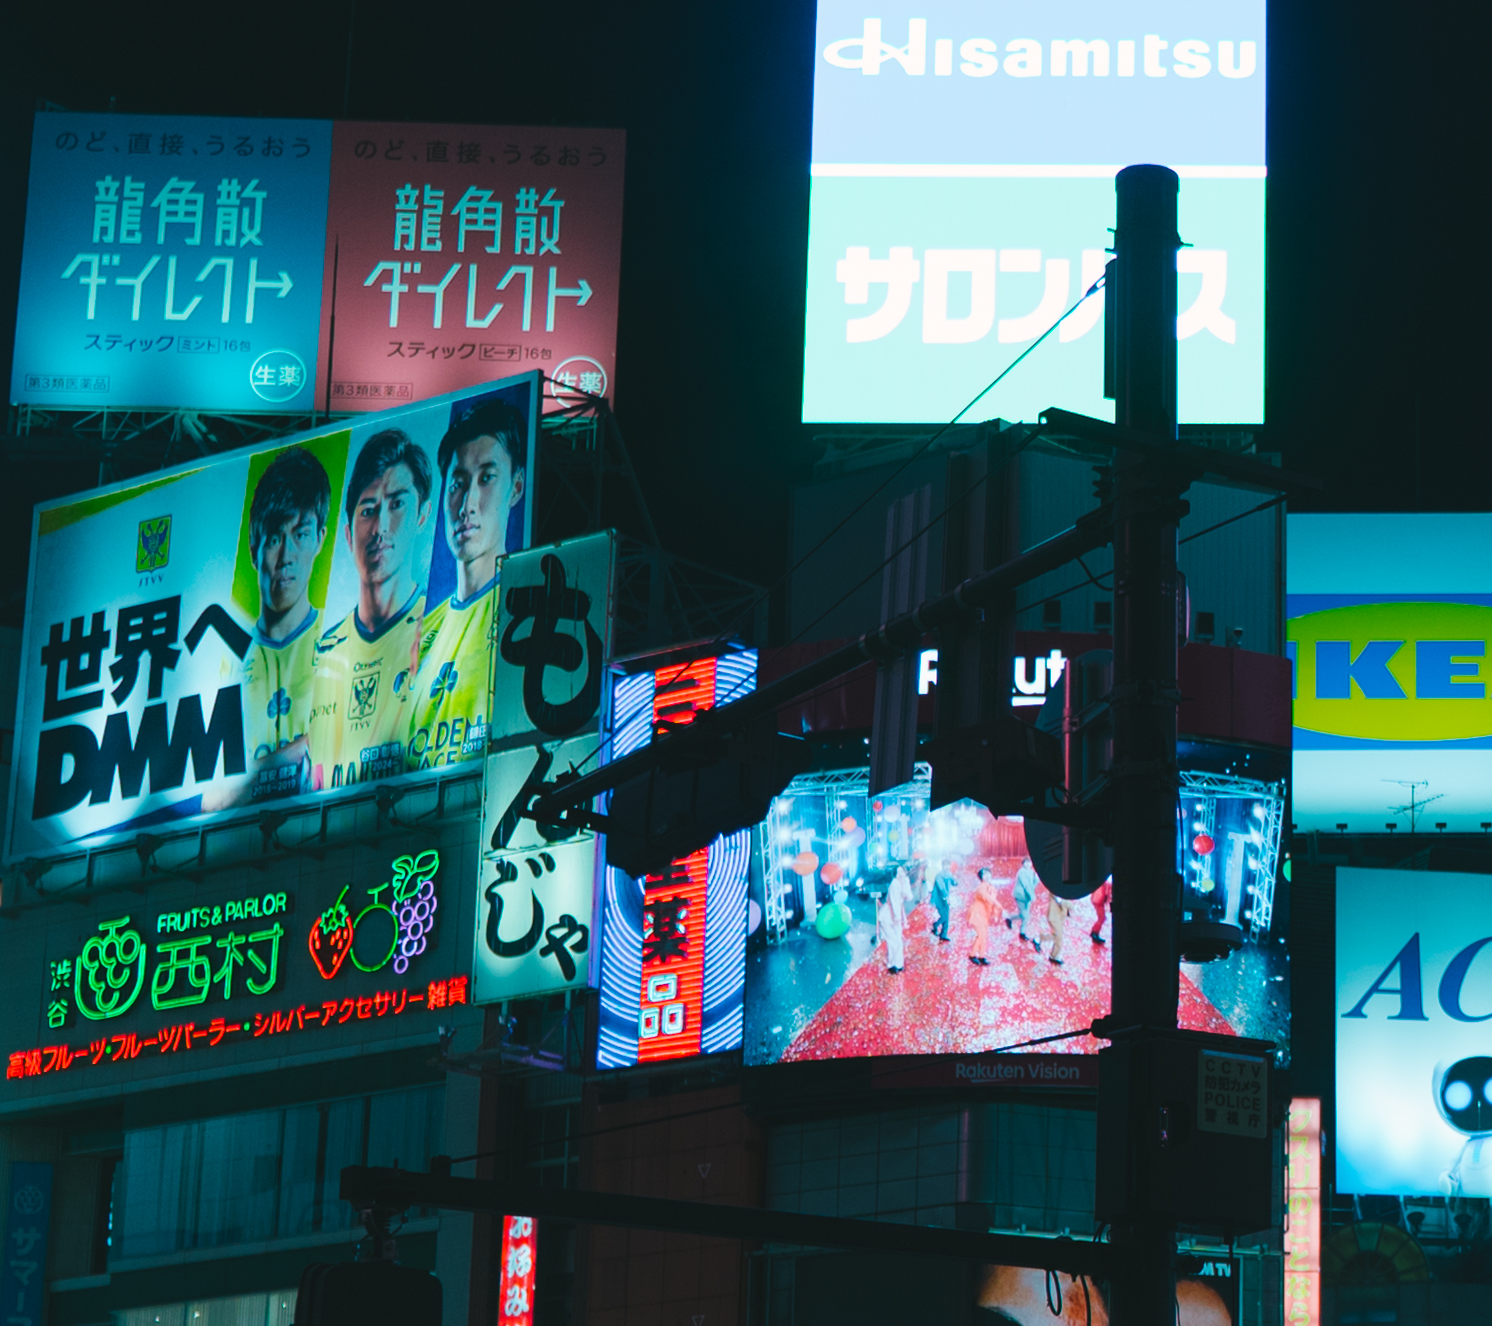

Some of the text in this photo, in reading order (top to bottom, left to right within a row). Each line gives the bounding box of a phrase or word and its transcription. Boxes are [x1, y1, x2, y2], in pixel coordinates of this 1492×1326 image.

[823, 17, 1257, 79] Hisamitsu
[55, 131, 311, 158] のど、直接、うるおう
[354, 140, 607, 167] のど、直接、うるおう
[92, 175, 267, 248] 龍角散
[394, 183, 565, 256] 龍角散
[60, 253, 294, 324] ダイレクト
[363, 261, 593, 332] ダイレクト
[835, 245, 1236, 345] サロンス
[41, 594, 253, 723] 世界へ
[31, 683, 247, 821] DMM
[48, 960, 72, 1029] 渋谷
[151, 923, 284, 1011] 西村
[956, 1063, 1080, 1081] Rakuten Vision
[1204, 1091, 1261, 1111] POLICE
[1205, 1075, 1261, 1094] 防犯カメラ
